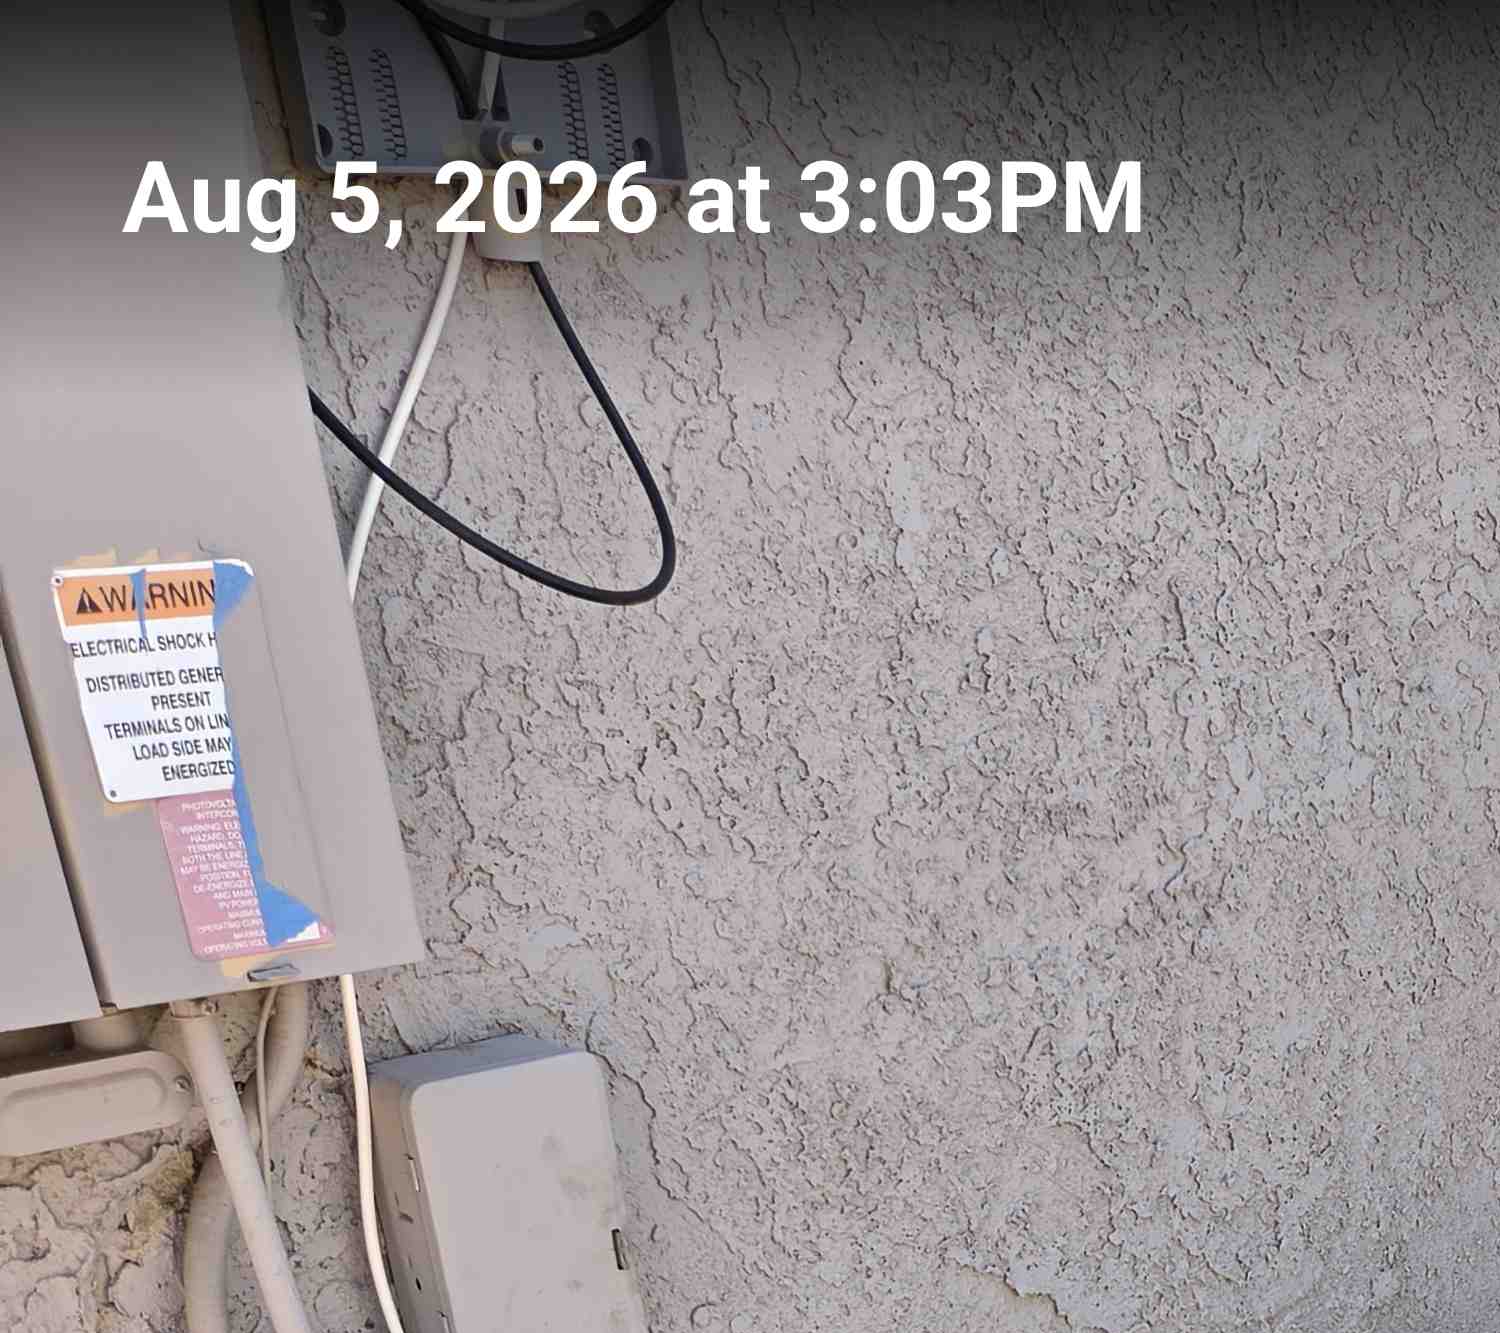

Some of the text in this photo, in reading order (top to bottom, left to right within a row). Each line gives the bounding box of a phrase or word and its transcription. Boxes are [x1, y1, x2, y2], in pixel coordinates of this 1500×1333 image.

[71, 637, 155, 658] ELECTRICAL
[158, 632, 205, 651] SHOCK
[85, 666, 224, 693] DISTRIBUTED GENER
[151, 691, 212, 711] PRESENT
[104, 718, 182, 740] TERMINALS
[184, 715, 205, 732] ON
[132, 737, 232, 760] LOAD SIDE MAY
[162, 760, 236, 781] ENERGIZED
